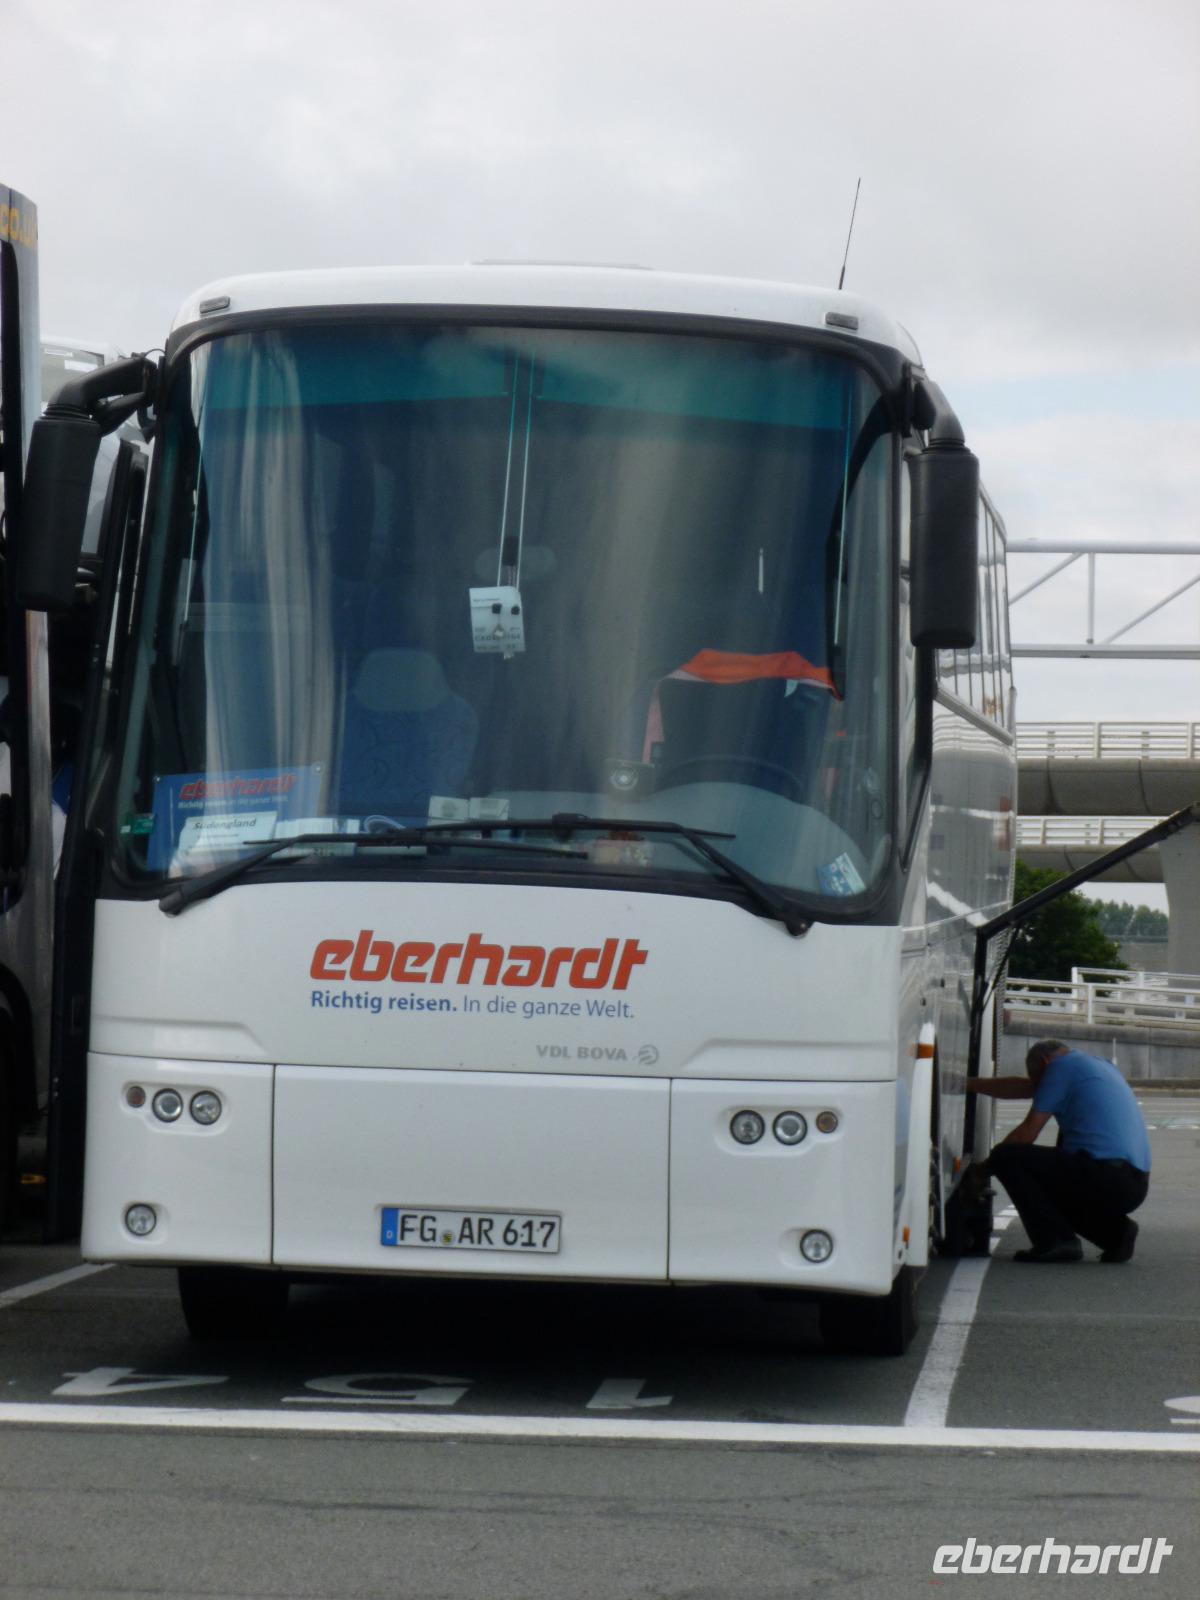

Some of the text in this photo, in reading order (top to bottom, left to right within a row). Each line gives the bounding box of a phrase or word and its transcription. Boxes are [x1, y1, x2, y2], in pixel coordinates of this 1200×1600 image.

[310, 929, 648, 990] eberhardt
[311, 990, 635, 1019] Richtig reisen. In die ganze Welt.
[536, 1044, 627, 1062] VDL BOVA
[400, 1214, 556, 1248] FG AR 617
